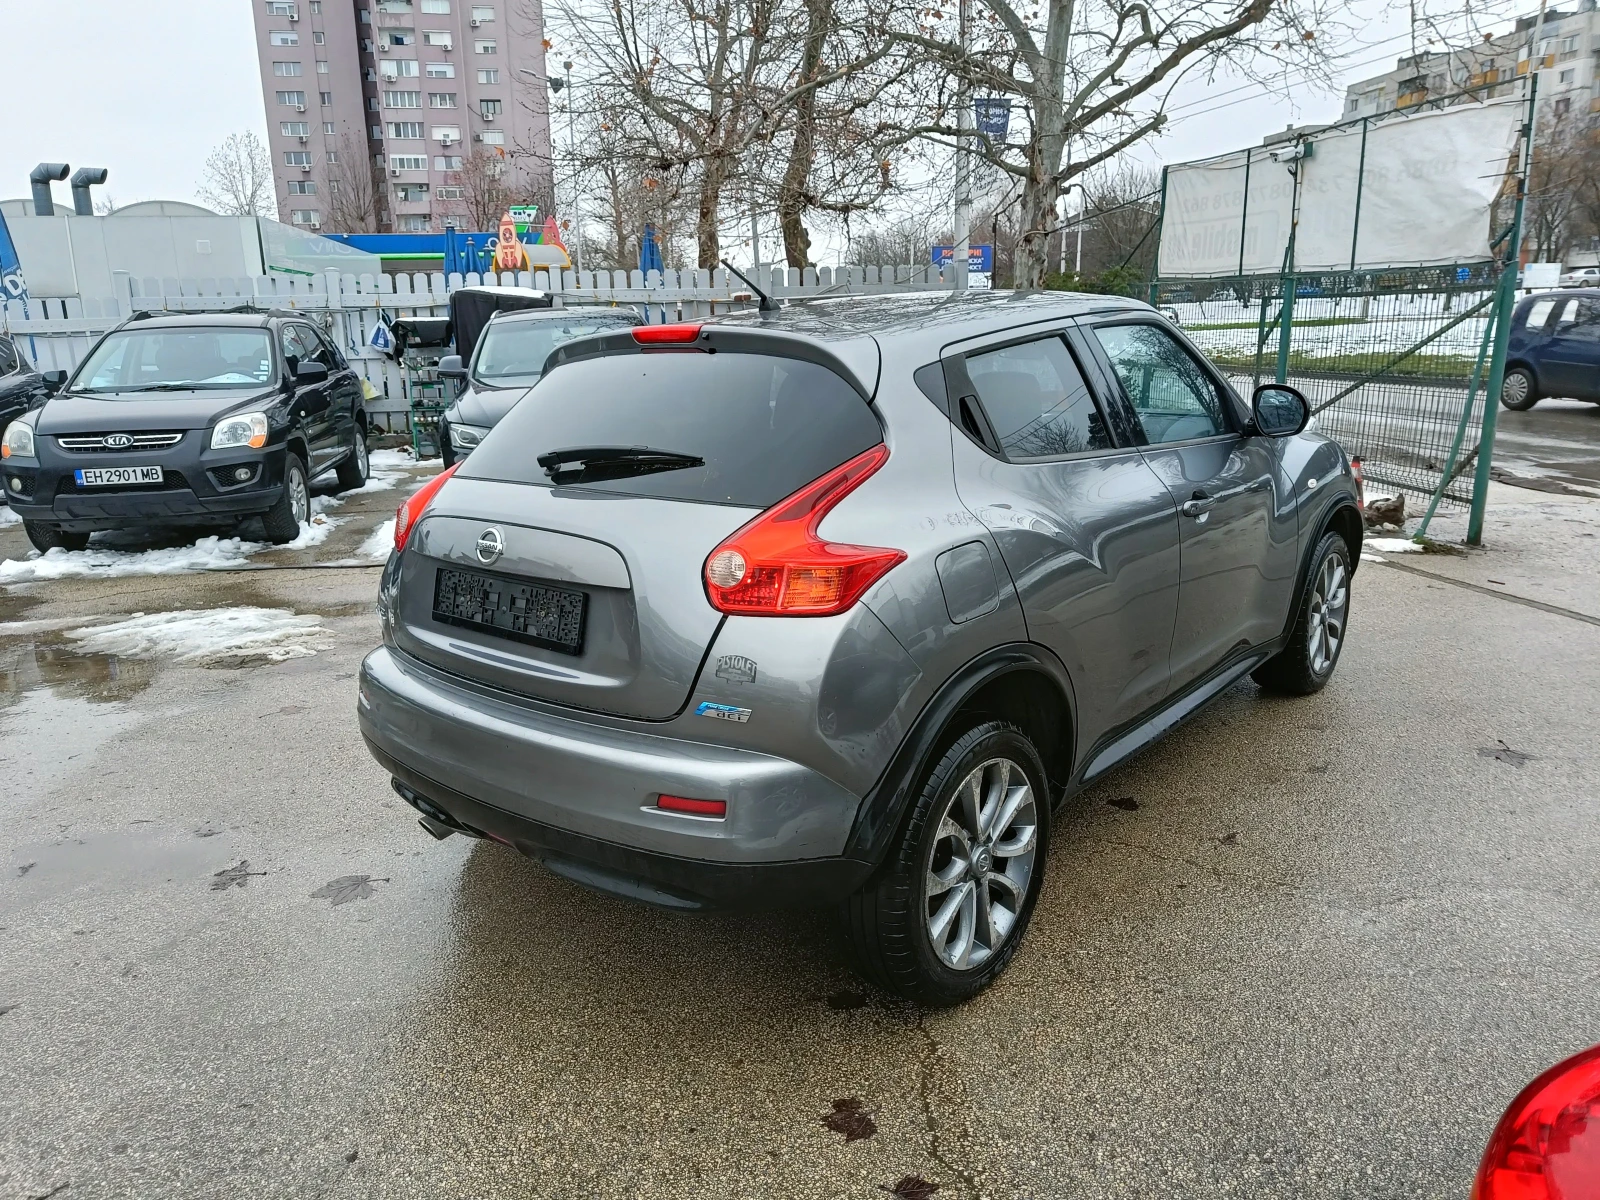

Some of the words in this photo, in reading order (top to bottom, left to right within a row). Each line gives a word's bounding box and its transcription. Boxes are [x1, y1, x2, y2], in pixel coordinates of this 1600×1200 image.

[107, 437, 128, 445] KIA
[84, 470, 104, 484] EH
[105, 469, 138, 482] 2901
[141, 468, 159, 481] MB
[718, 656, 757, 676] PISTOLET
